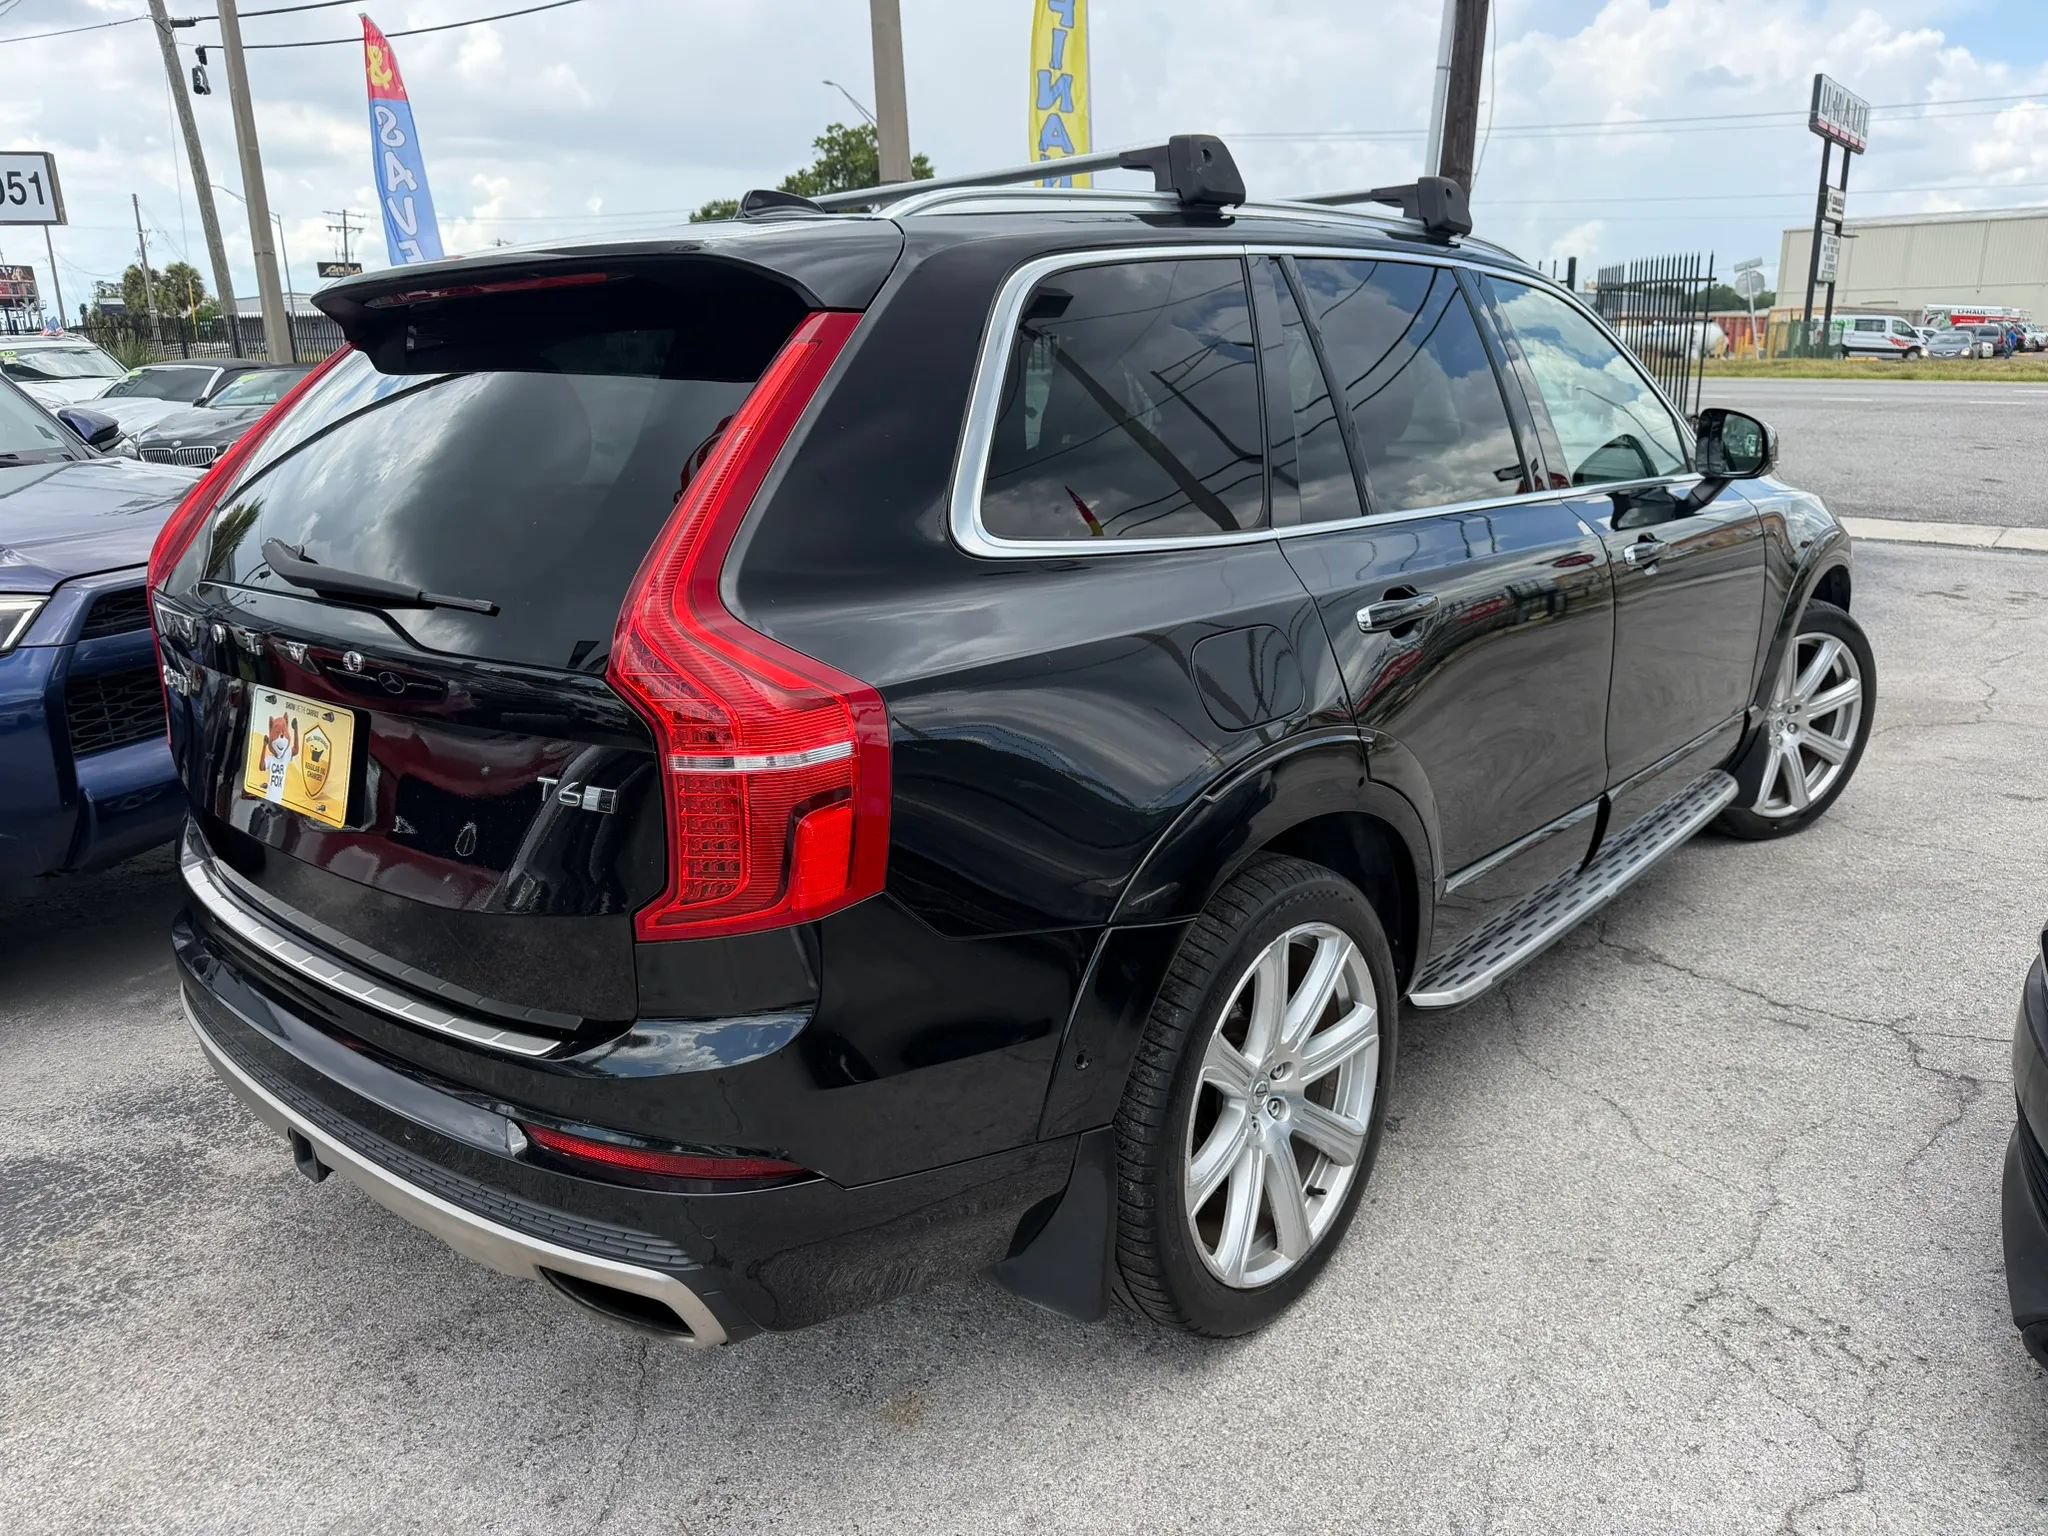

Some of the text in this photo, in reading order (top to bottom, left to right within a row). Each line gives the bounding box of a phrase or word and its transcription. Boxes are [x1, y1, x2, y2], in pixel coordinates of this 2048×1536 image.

[0, 170, 45, 206] 51
[271, 763, 285, 776] CAR
[270, 775, 283, 788] FOX
[537, 777, 582, 807] T6
